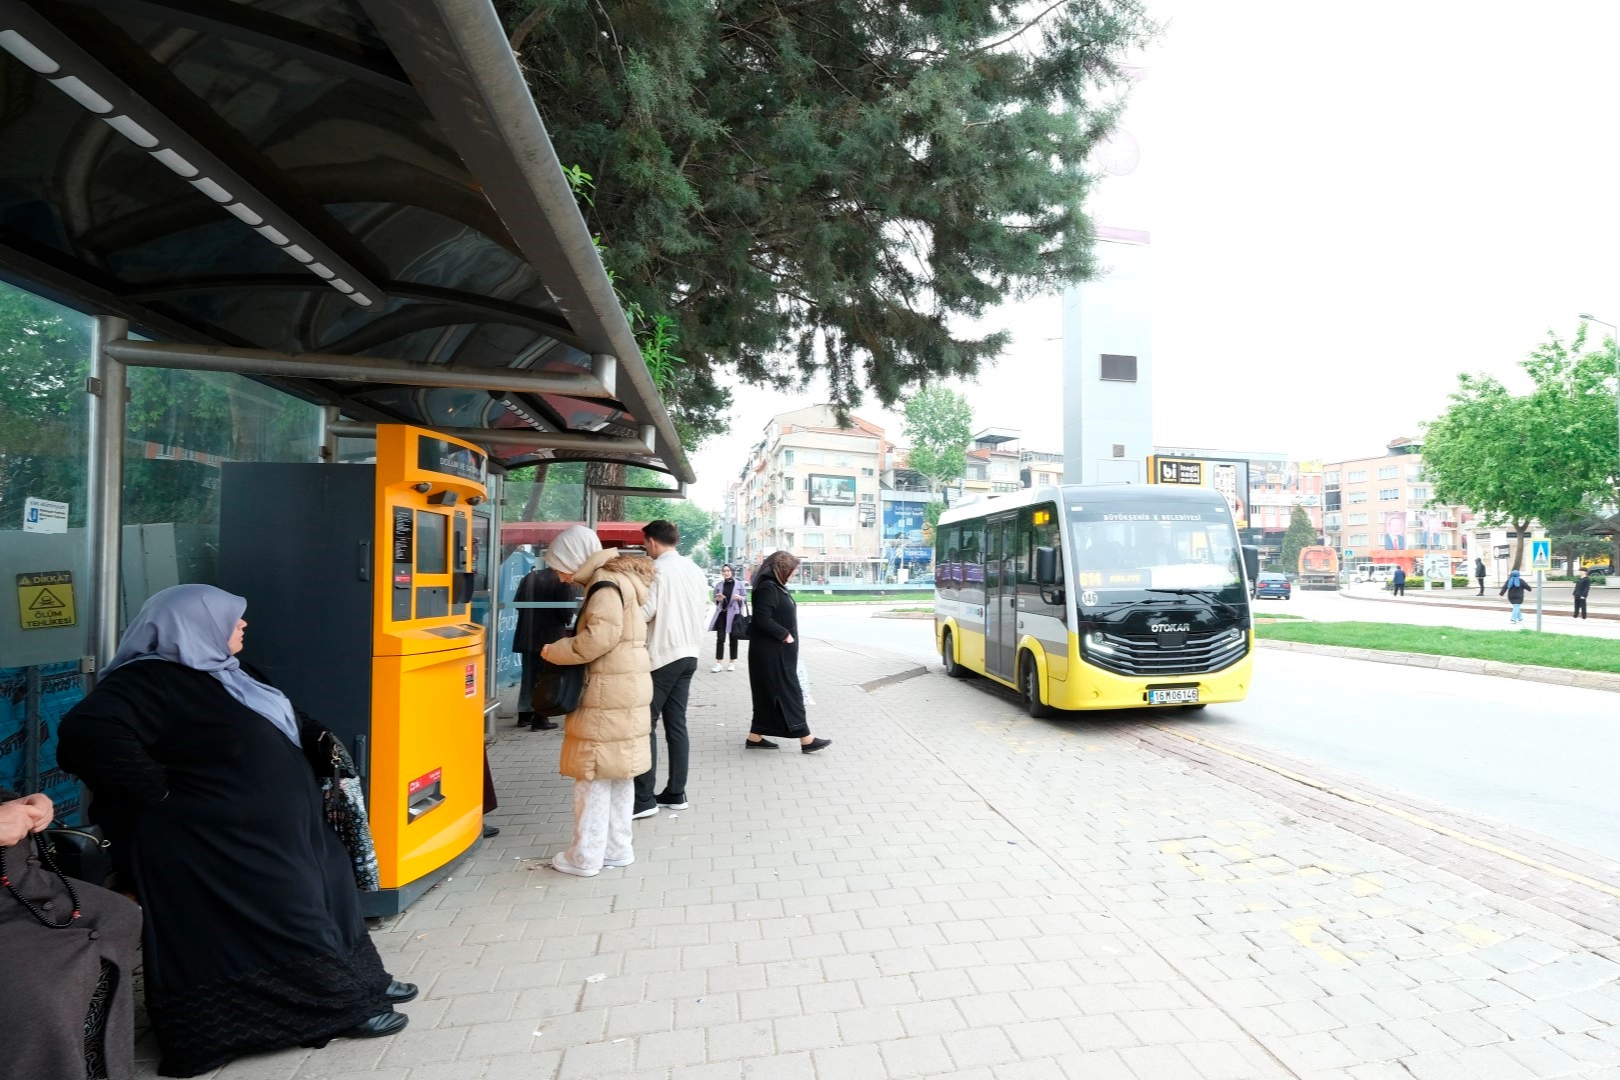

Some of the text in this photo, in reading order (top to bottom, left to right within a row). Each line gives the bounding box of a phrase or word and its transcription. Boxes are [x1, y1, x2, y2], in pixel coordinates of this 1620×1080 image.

[1163, 463, 1177, 479] bi
[33, 572, 70, 584] DİKKAT
[1083, 593, 1097, 604] 146
[34, 610, 62, 619] ÖLÜM
[26, 617, 72, 628] TEHLİKESİ
[1151, 623, 1190, 632] OTOKAR
